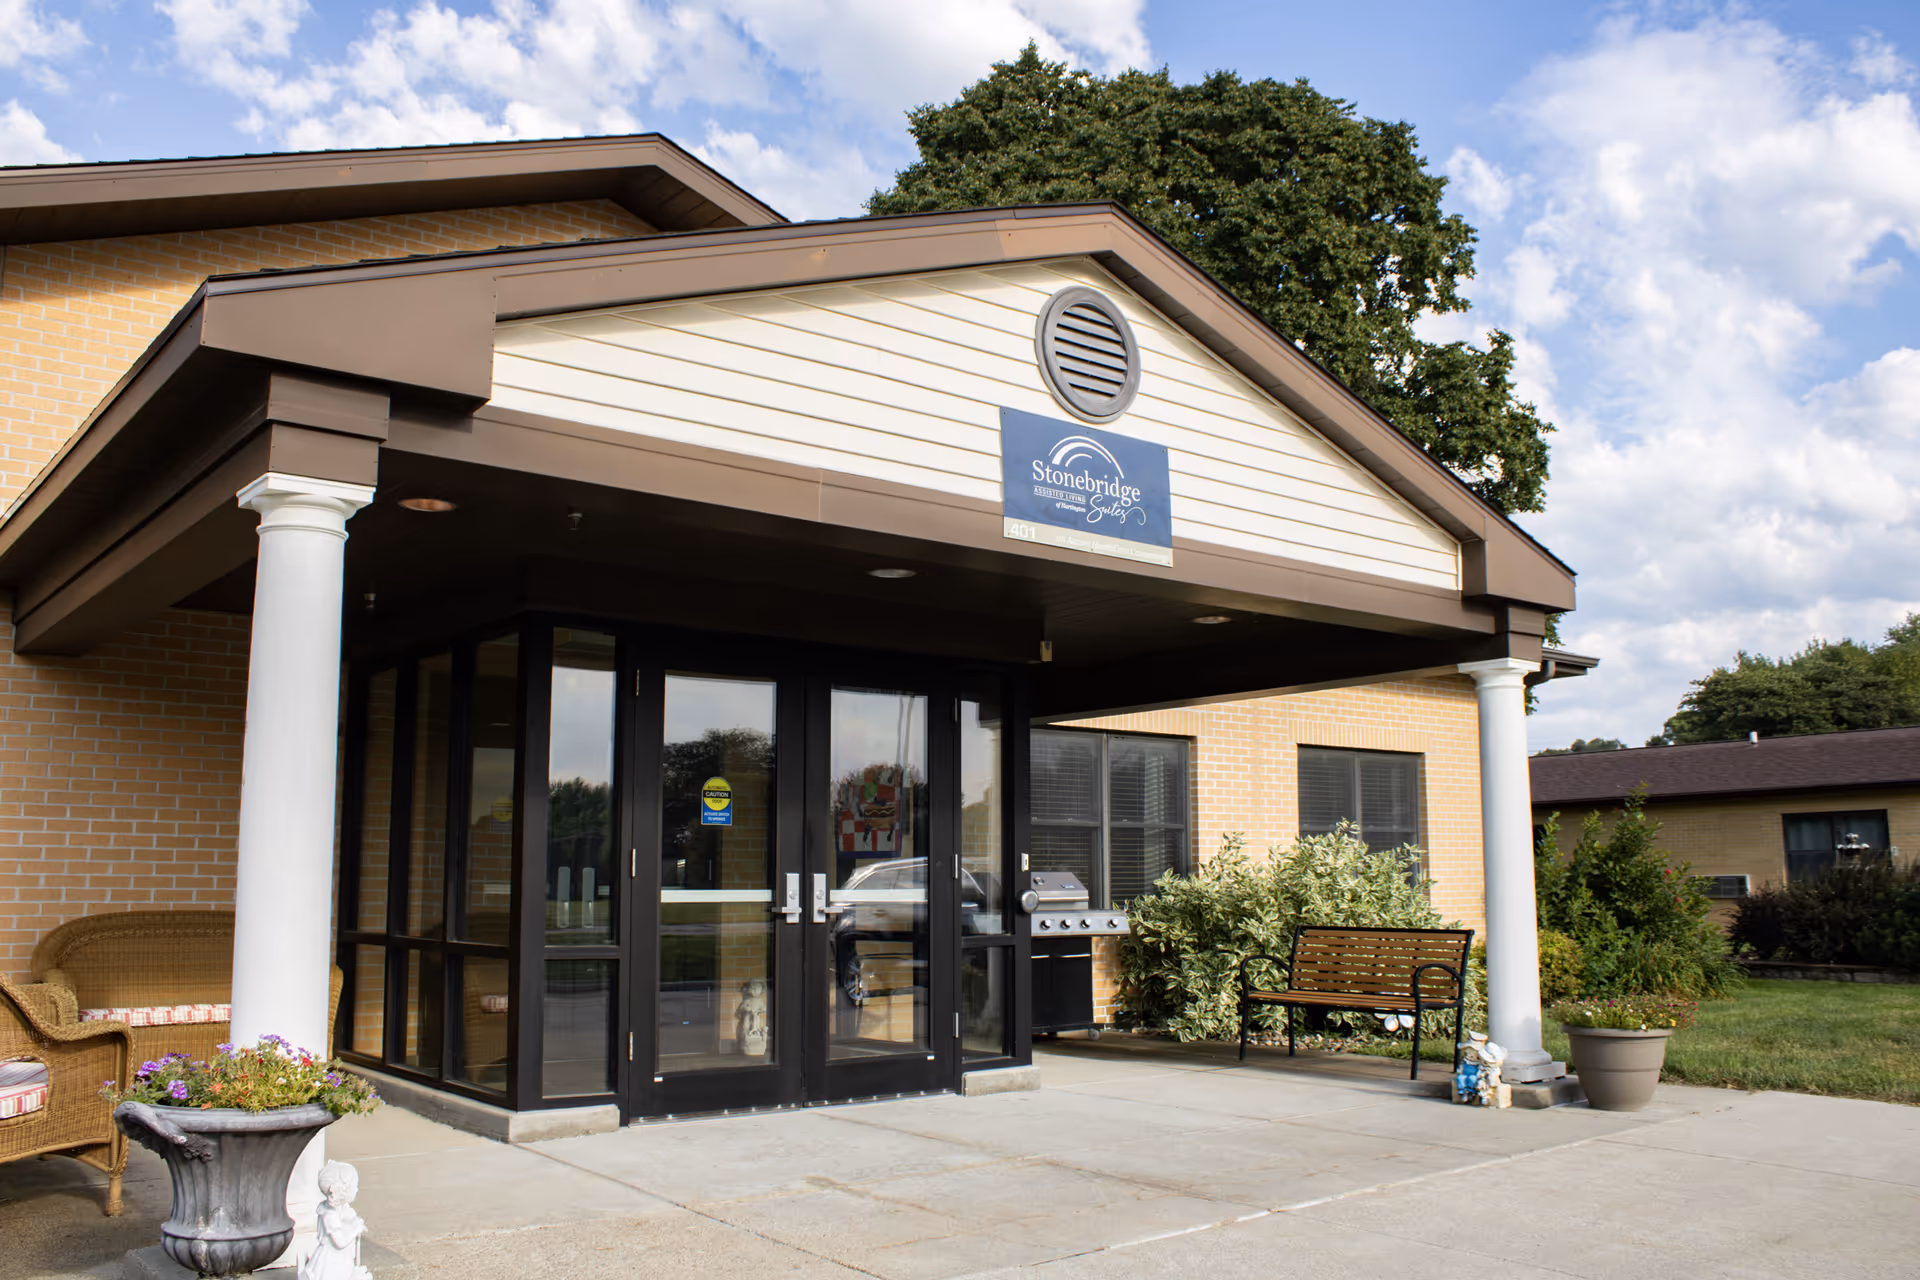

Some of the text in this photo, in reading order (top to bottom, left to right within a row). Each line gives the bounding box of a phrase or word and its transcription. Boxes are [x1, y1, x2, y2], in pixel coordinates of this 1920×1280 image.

[1032, 460, 1140, 506] Stonebridge
[1033, 487, 1086, 503] ASSISTED LIVING
[1087, 495, 1146, 525] Suites
[1010, 523, 1036, 539] 401
